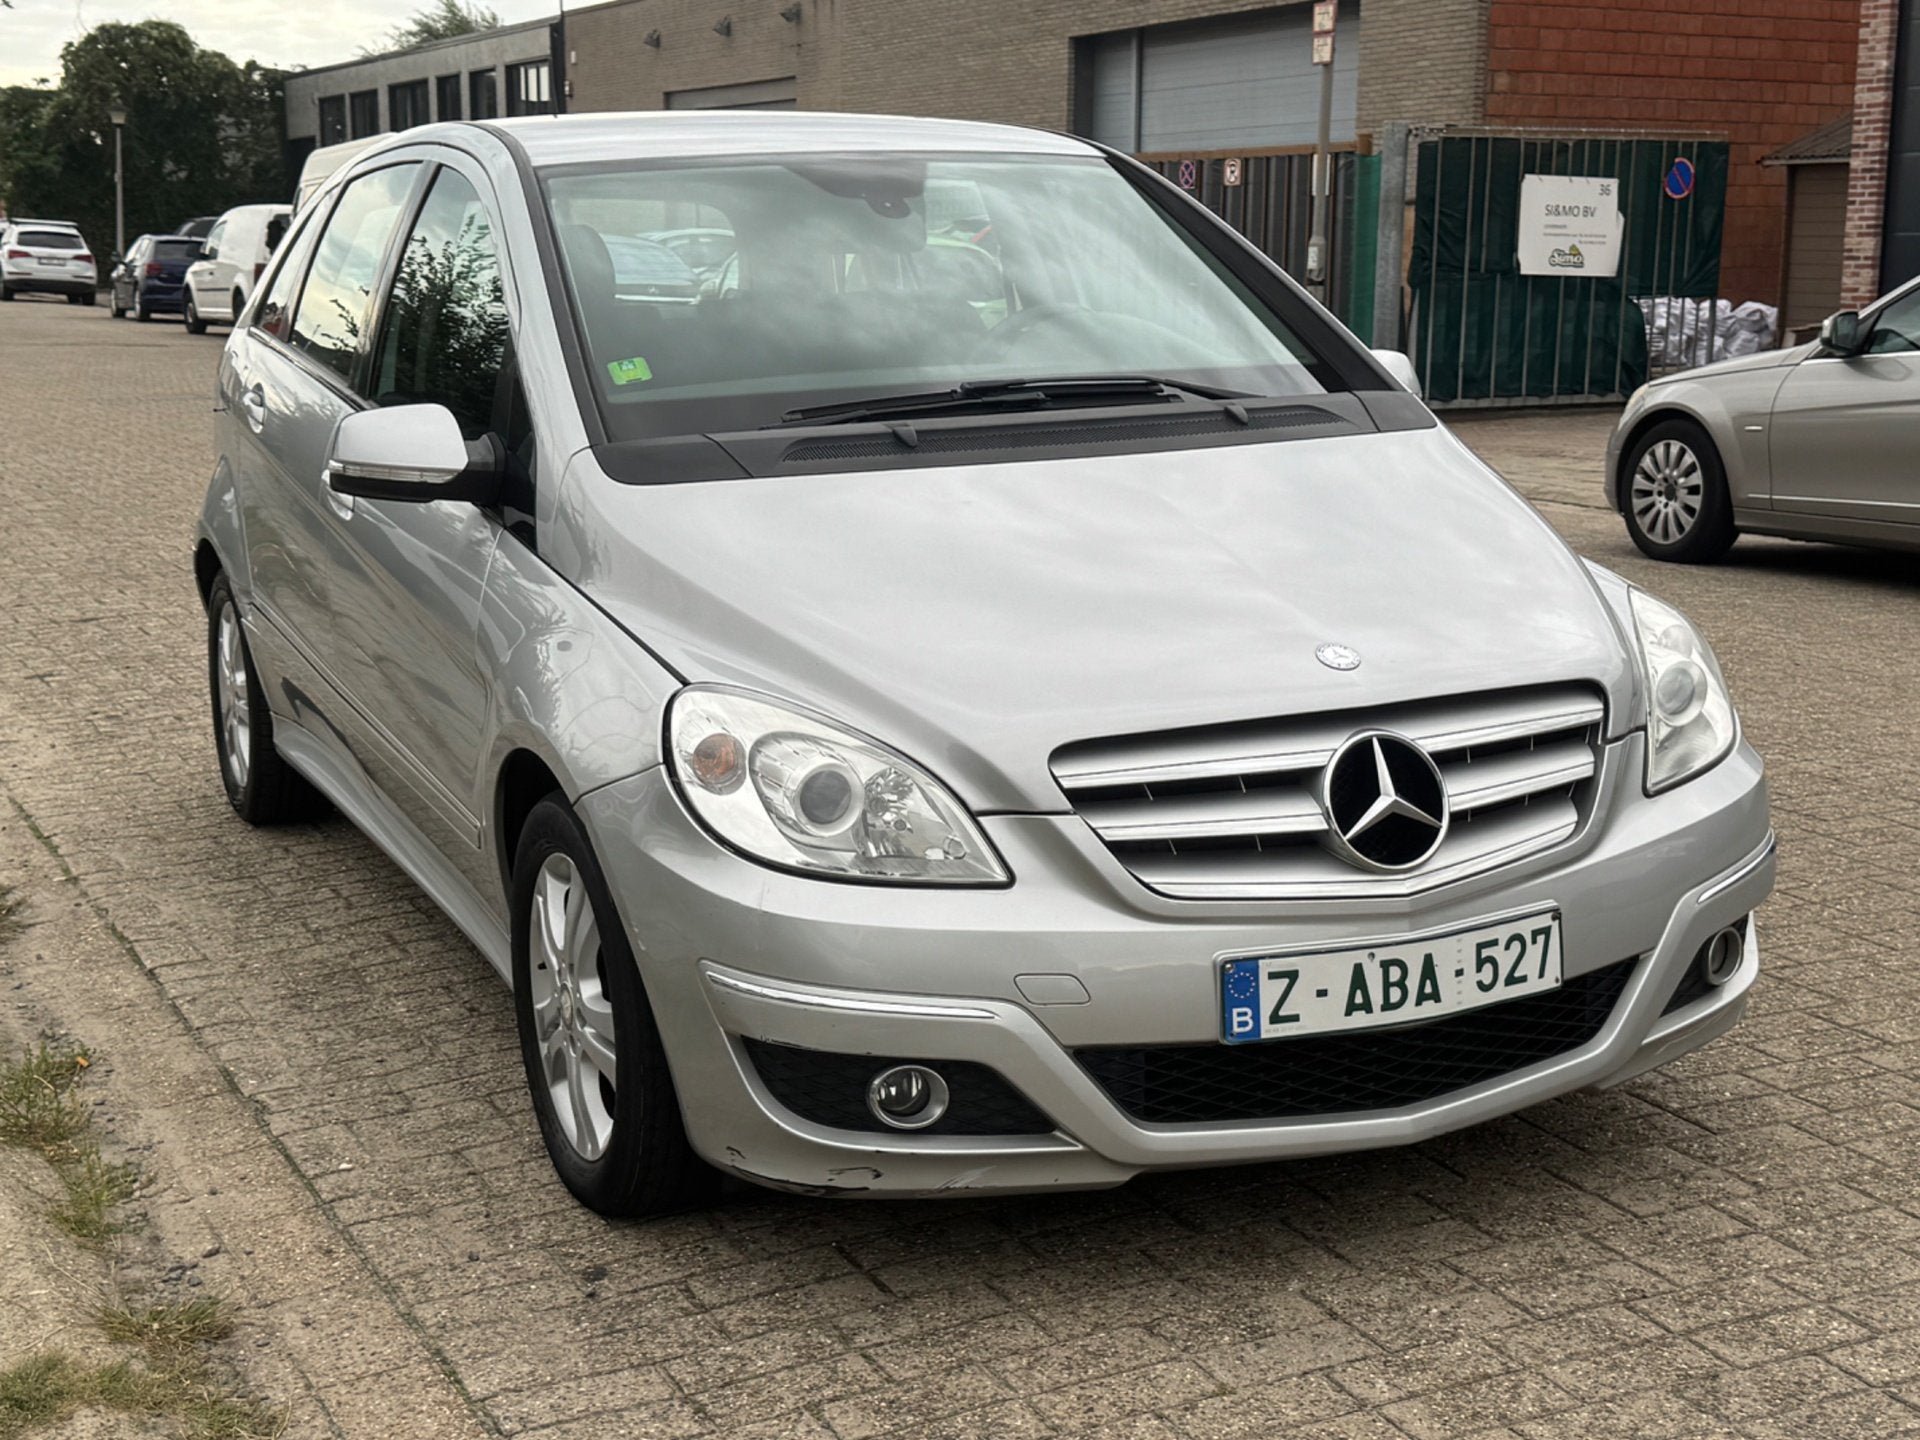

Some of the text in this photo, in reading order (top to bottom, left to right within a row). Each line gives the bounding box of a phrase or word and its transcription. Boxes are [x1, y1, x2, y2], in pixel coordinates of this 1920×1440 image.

[1599, 184, 1611, 196] 36
[1545, 204, 1597, 217] SI&MO BV
[1232, 1007, 1253, 1033] B
